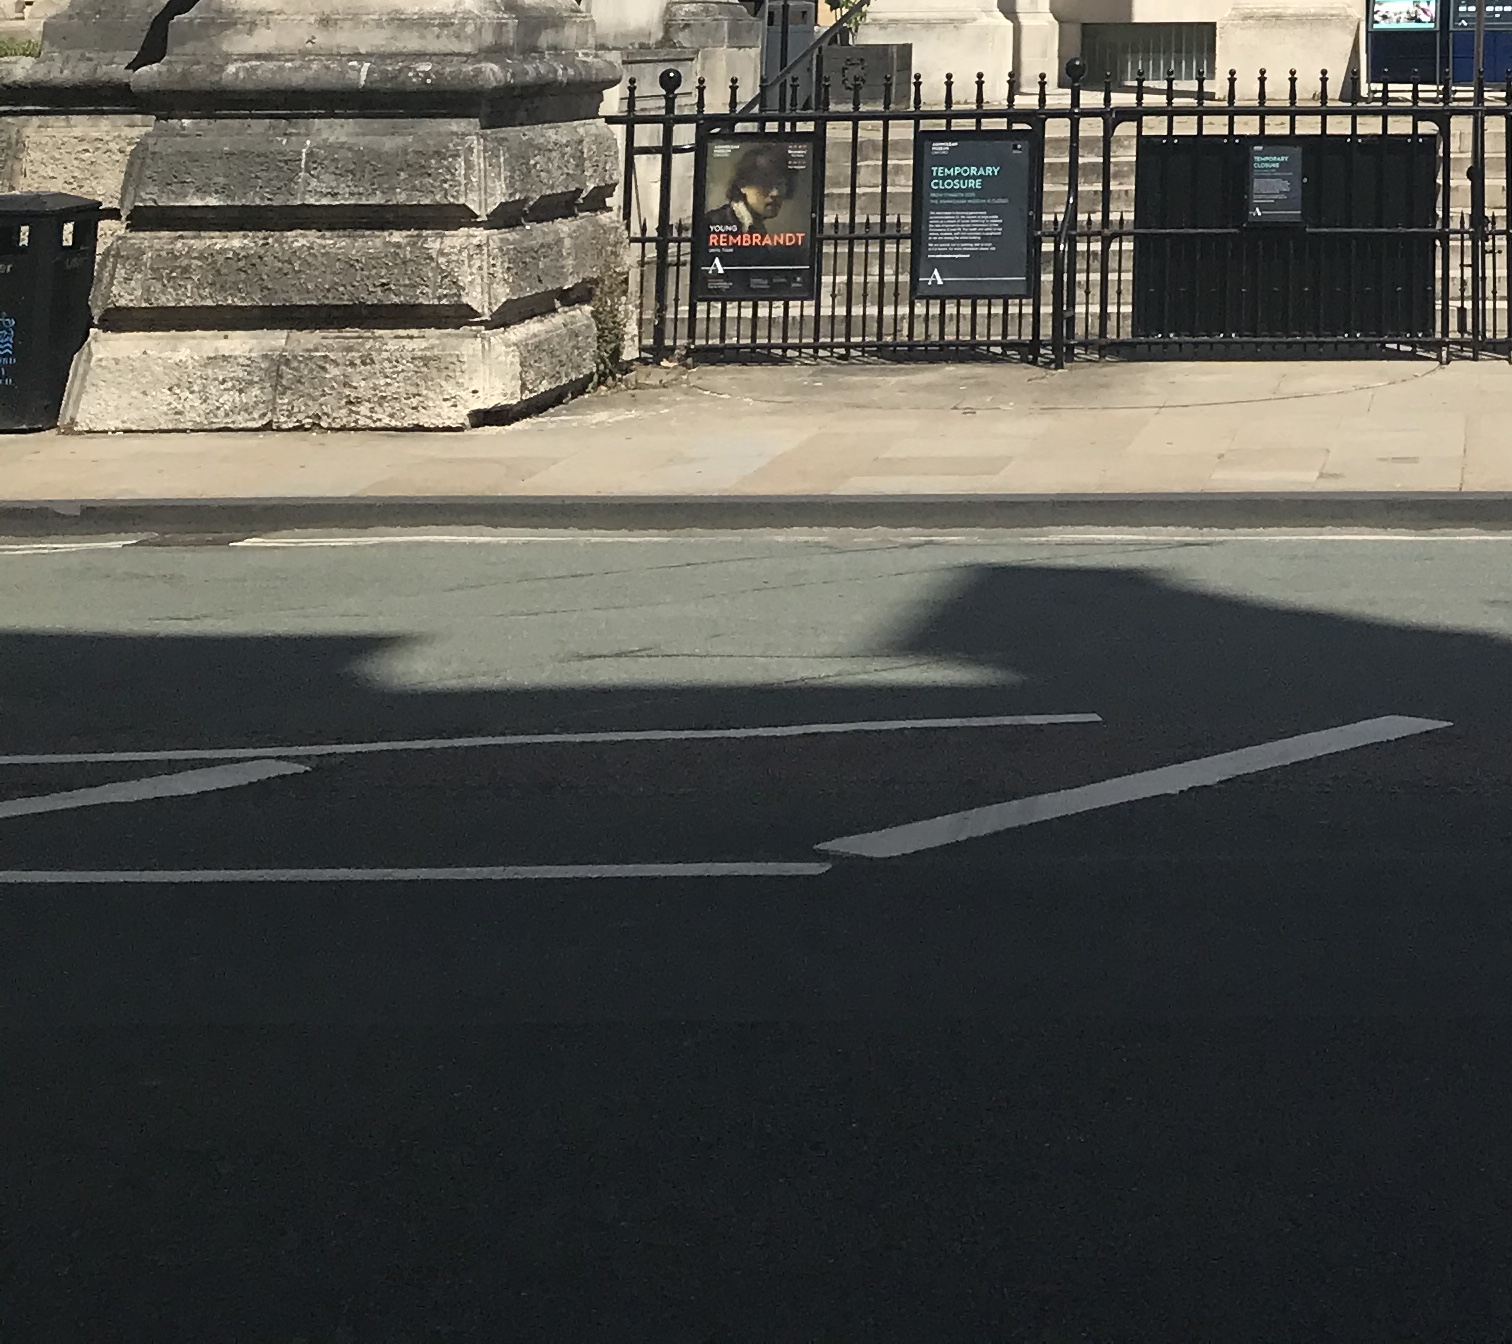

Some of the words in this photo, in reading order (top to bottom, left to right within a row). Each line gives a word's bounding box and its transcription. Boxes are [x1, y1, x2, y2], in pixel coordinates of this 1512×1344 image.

[931, 166, 1000, 177] TEMPORARY
[930, 179, 982, 189] CLOSURE
[708, 233, 805, 247] REMBRANDT
[708, 256, 724, 274] A
[928, 268, 944, 285] A
